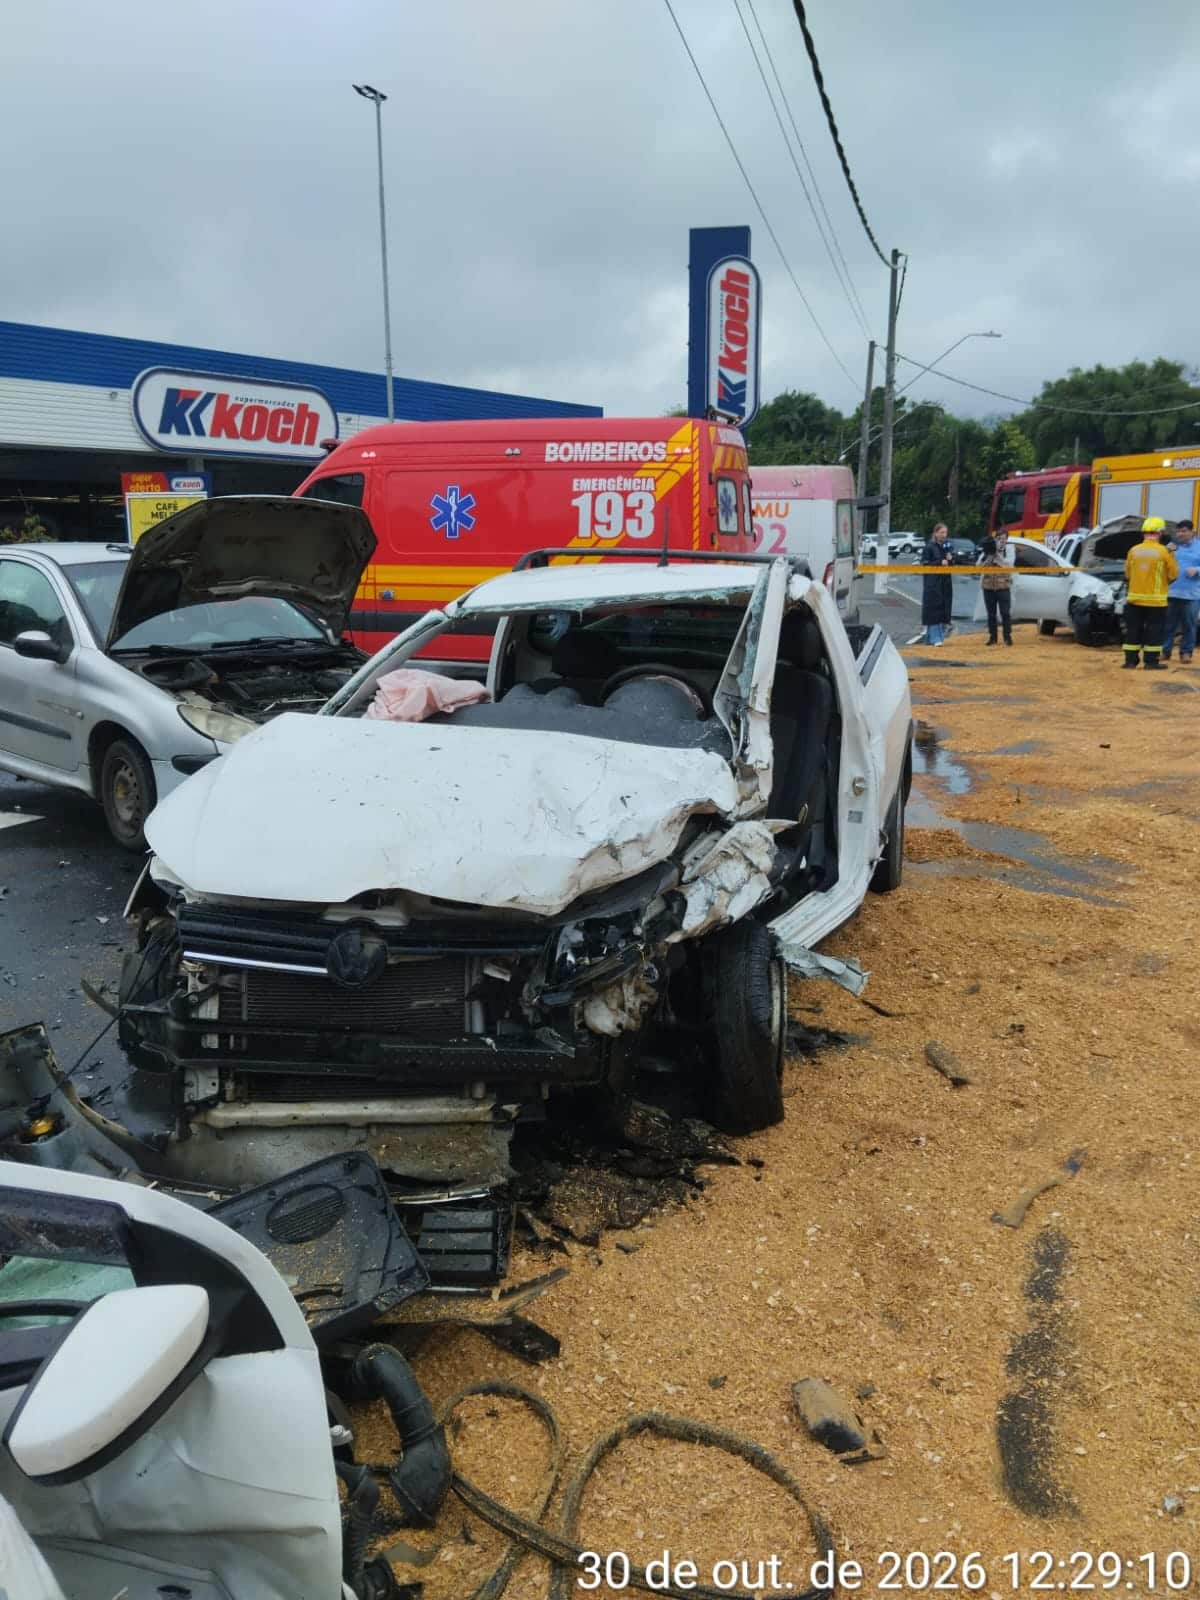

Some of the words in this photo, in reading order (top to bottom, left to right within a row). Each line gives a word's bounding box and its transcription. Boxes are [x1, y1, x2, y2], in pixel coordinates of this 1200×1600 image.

[544, 441, 668, 462] BOMBEIROS
[572, 475, 655, 492] EMERGÊNCIA
[155, 500, 179, 511] CAFÉ
[753, 502, 789, 518] MU
[571, 492, 656, 539] 193
[751, 523, 788, 554] 92
